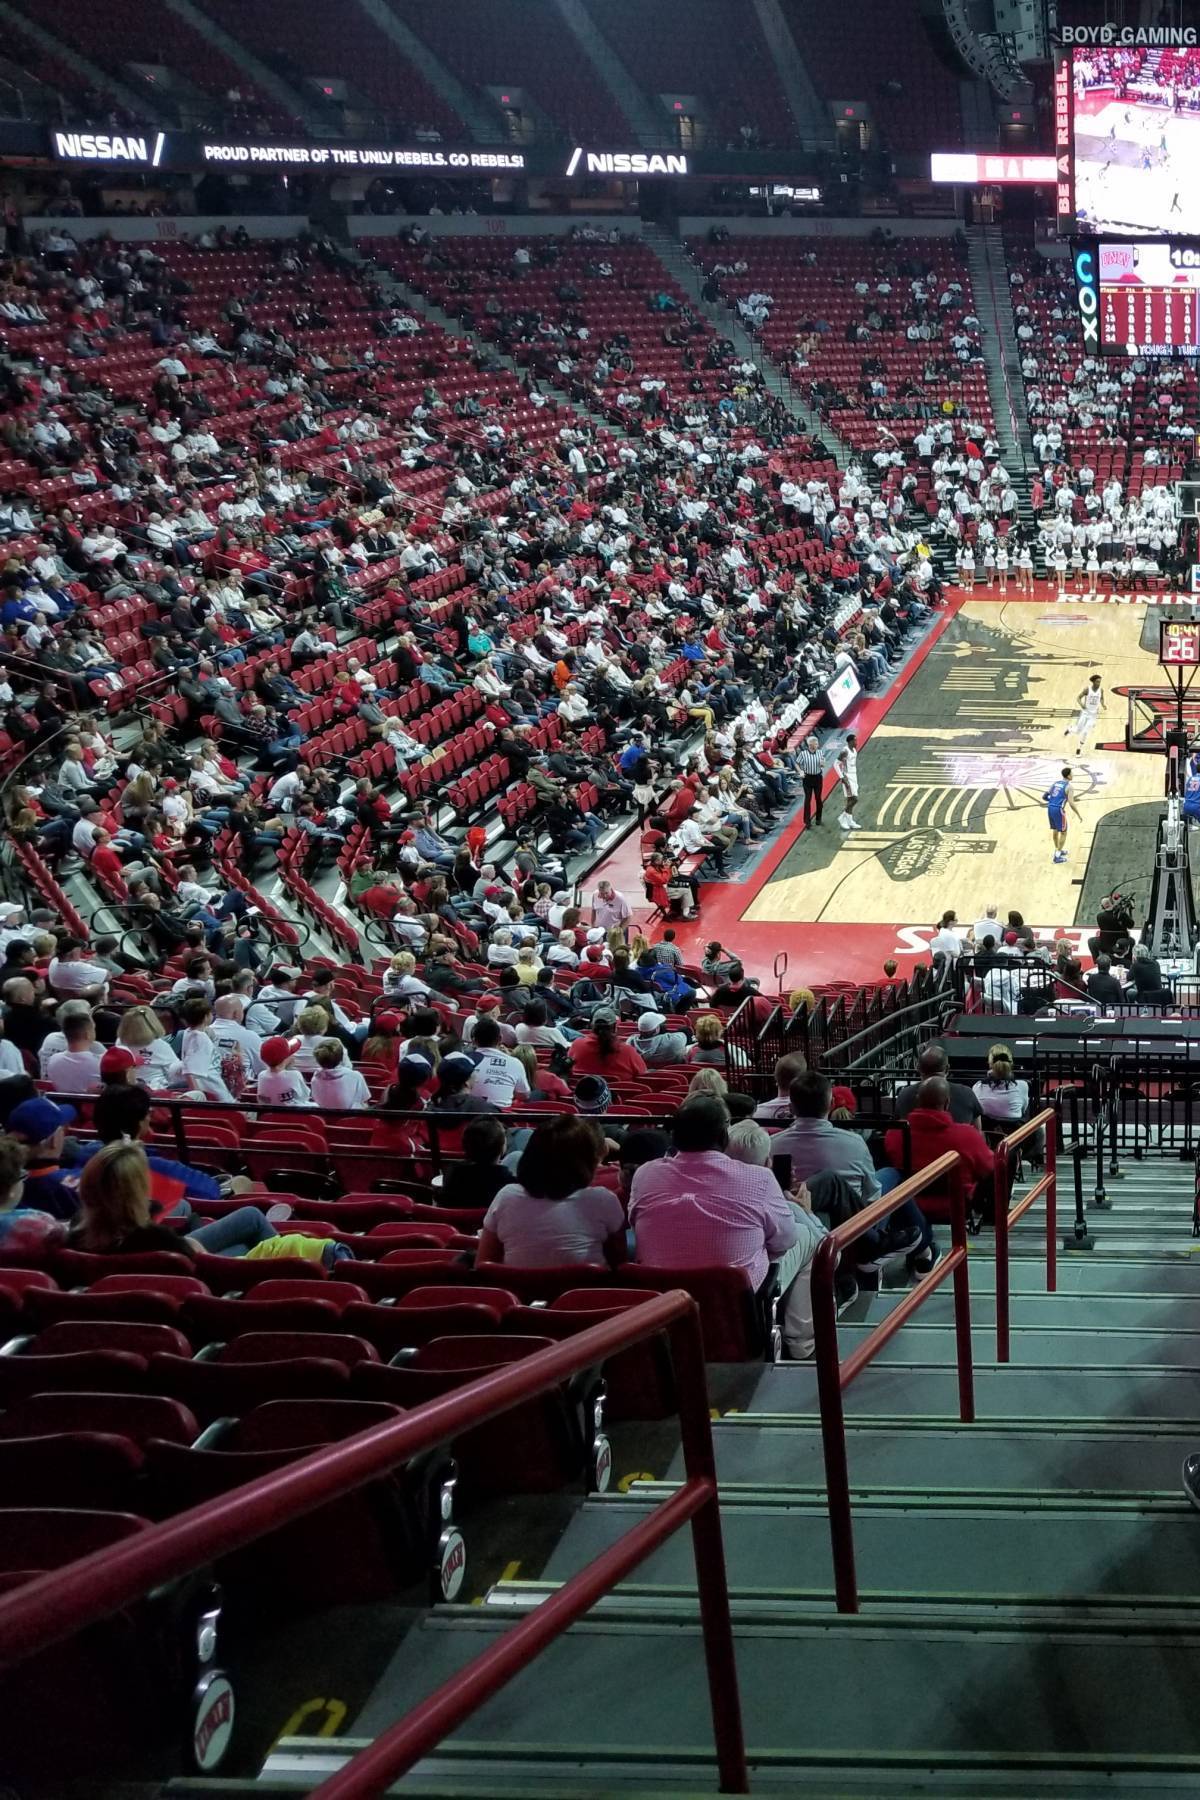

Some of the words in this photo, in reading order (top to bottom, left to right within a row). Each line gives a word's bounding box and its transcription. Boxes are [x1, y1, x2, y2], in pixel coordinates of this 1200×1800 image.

[1062, 26, 1113, 44] BOYD
[1120, 26, 1198, 44] GAMING
[55, 133, 148, 160] NISSAN
[204, 146, 248, 160] PROUD
[250, 147, 310, 162] PARTNER
[311, 149, 330, 163] OF
[331, 149, 358, 163] THE
[359, 150, 394, 164] UNLV
[394, 151, 448, 166] REBELS.
[449, 152, 469, 166] GO
[471, 153, 525, 168] REBELS!
[587, 153, 687, 174] NISSAN
[1057, 153, 1070, 175] A
[1058, 183, 1070, 214] BE
[1076, 252, 1099, 343] COX
[1167, 624, 1199, 637] 10:44
[1168, 638, 1195, 659] 26
[906, 835, 928, 850] LAS
[893, 850, 918, 875] VEGAS
